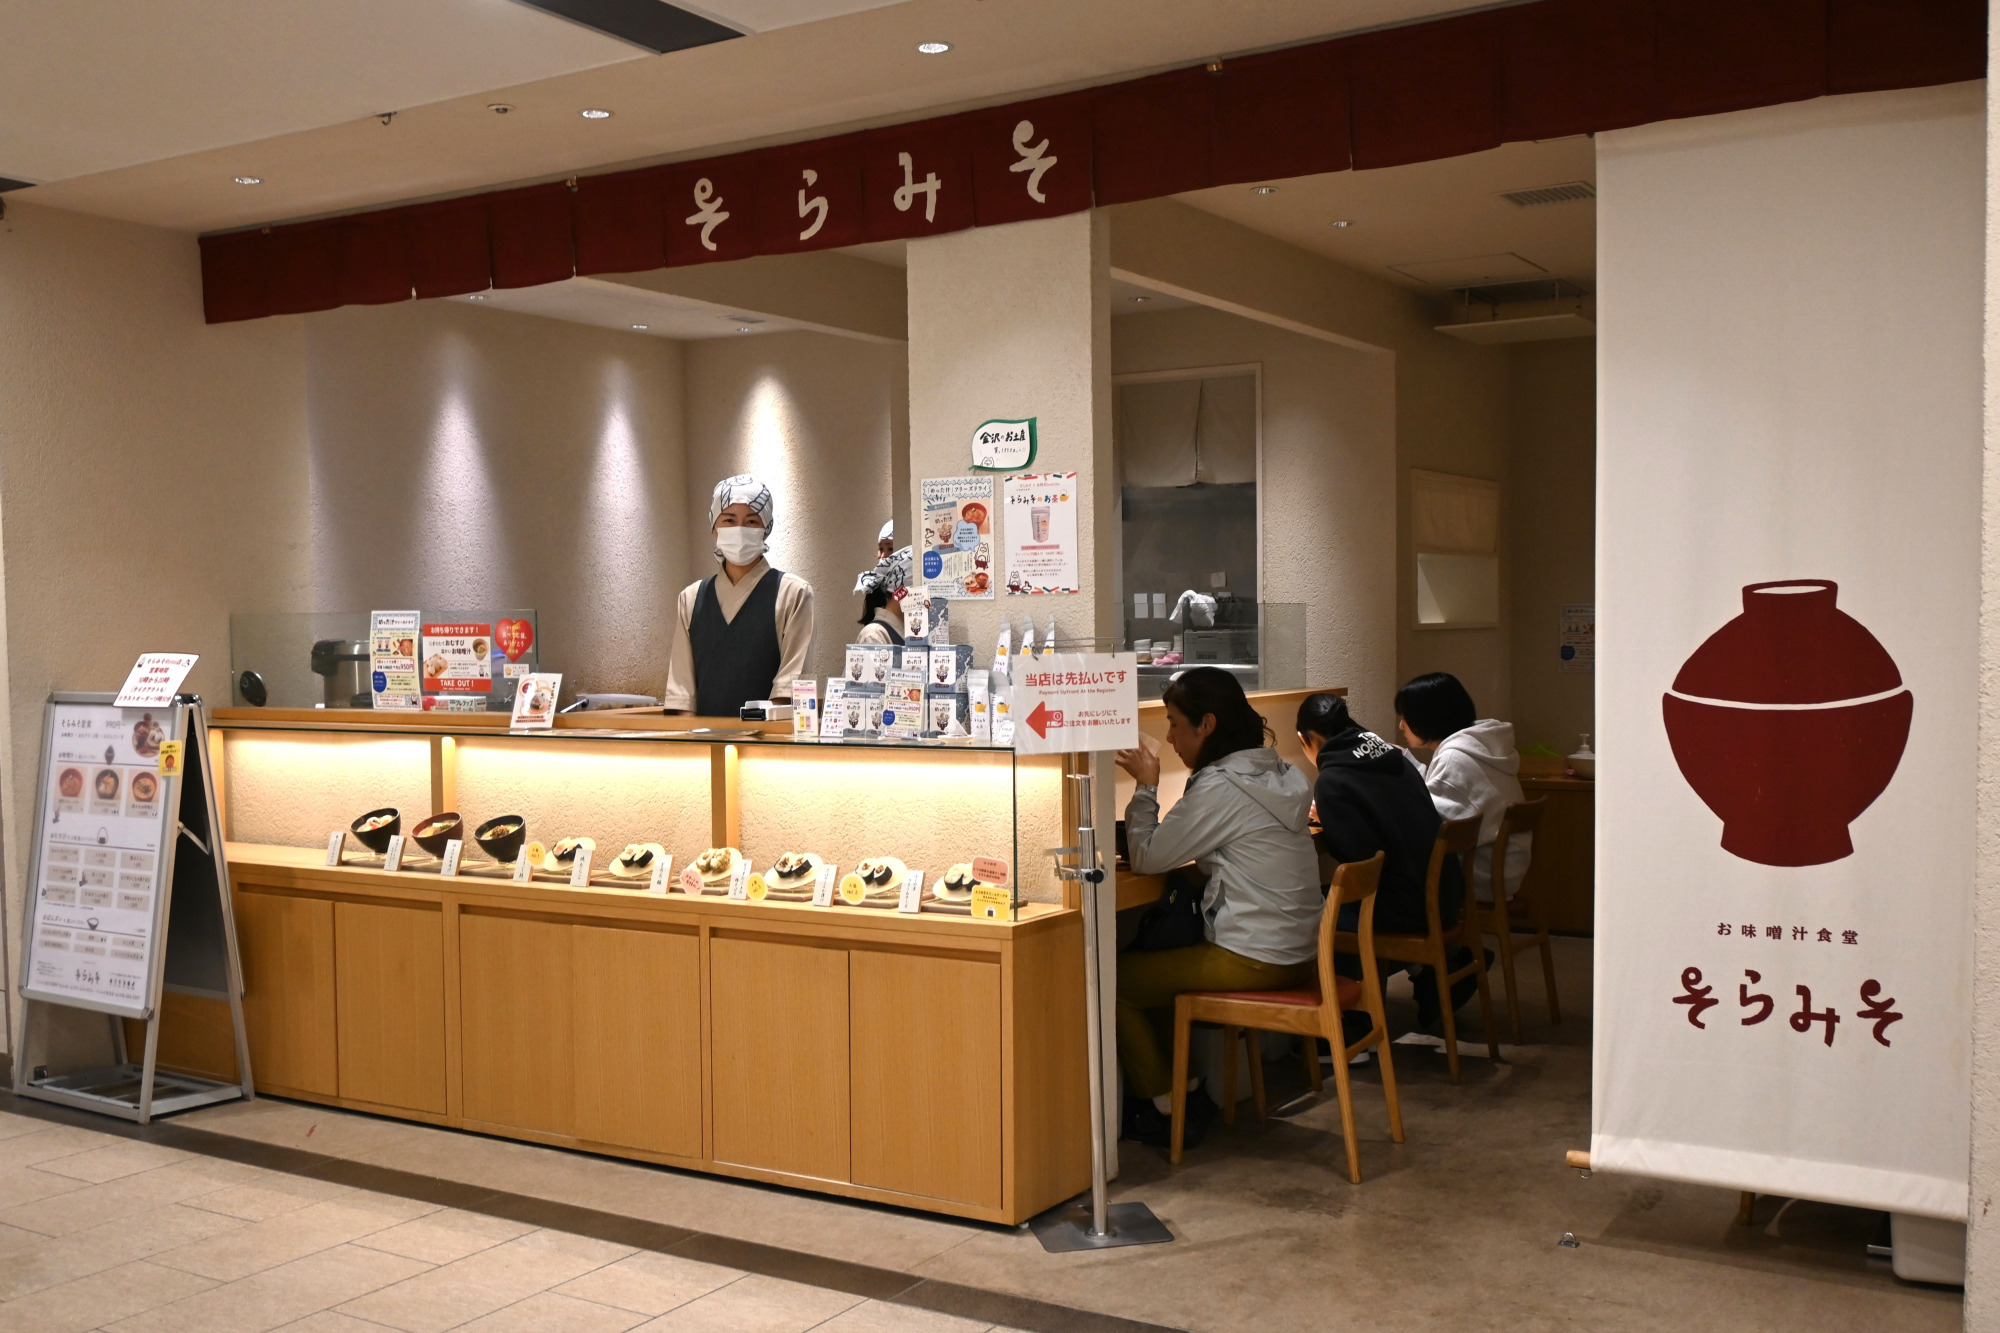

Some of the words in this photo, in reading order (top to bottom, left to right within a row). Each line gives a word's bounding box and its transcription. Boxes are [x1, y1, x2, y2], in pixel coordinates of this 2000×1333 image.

[685, 120, 1058, 251] そらみそ
[980, 429, 1026, 444] 金沢のお土産
[1025, 670, 1127, 687] 当店は先払いです
[1078, 709, 1118, 718] お先にレジにて
[1717, 922, 1859, 945] お味噌汁食堂
[1672, 966, 1904, 1047] そらみそ
